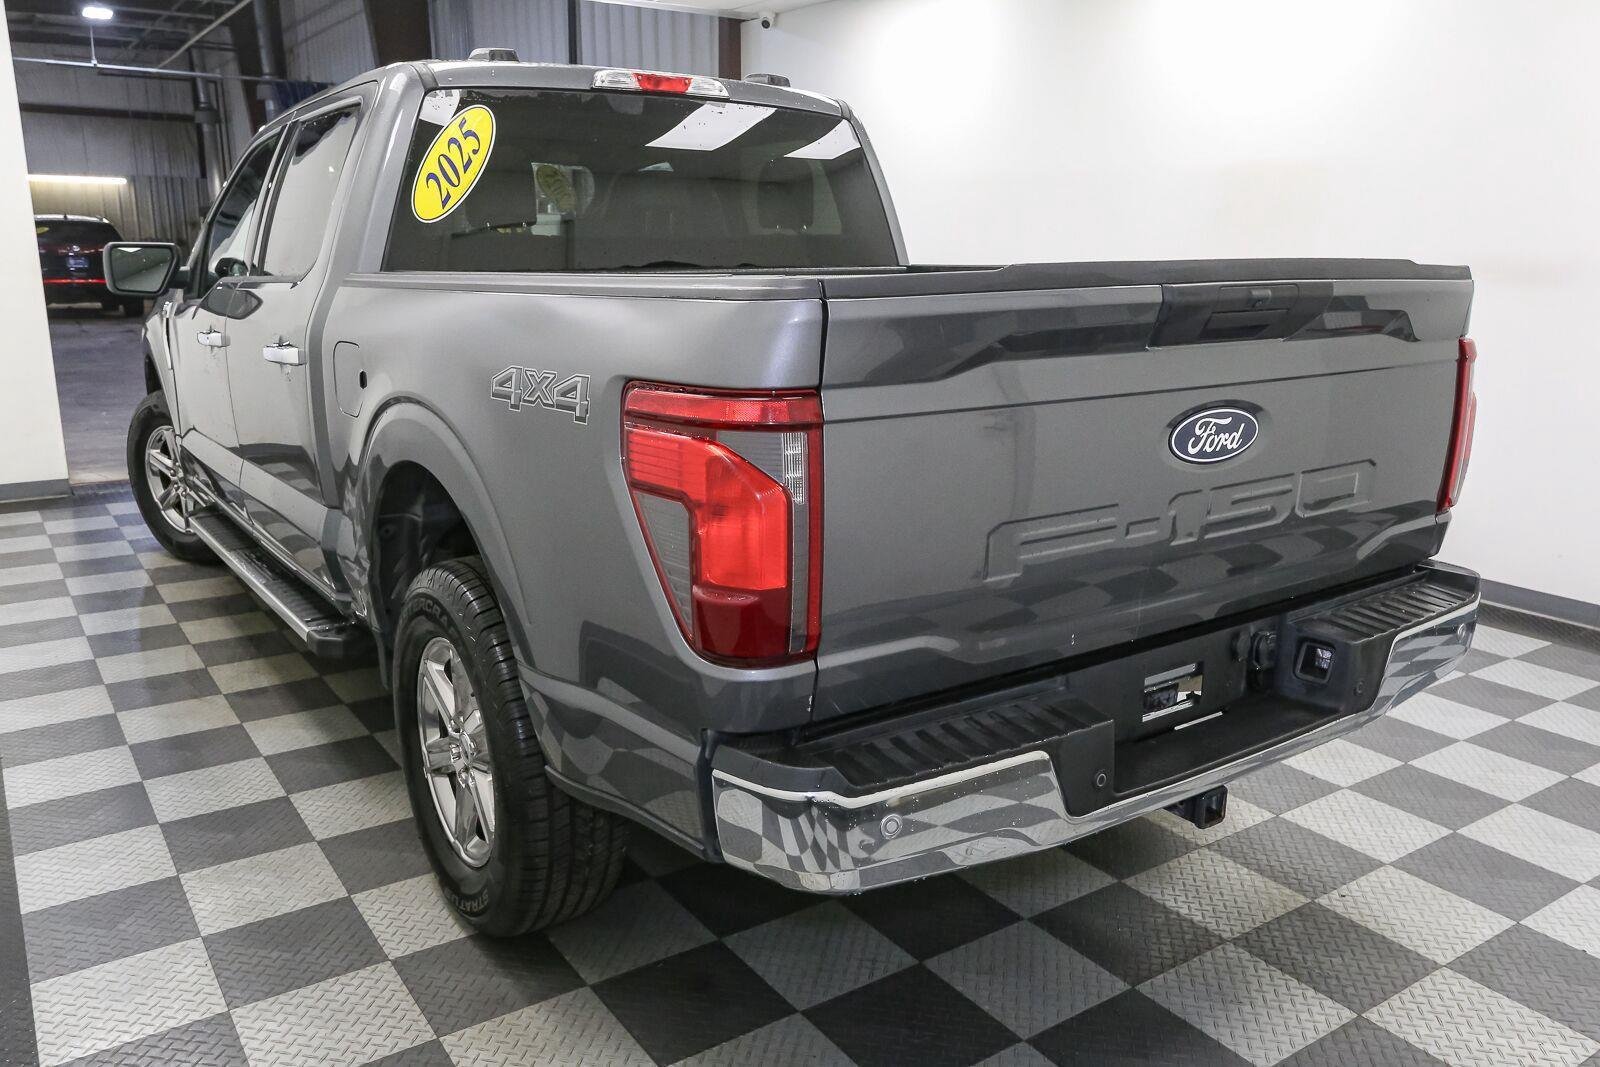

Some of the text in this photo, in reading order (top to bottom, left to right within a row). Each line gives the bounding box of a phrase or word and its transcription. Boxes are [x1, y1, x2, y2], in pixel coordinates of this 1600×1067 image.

[425, 116, 481, 210] 2025
[1187, 416, 1246, 455] Ford
[982, 459, 1376, 583] F-150
